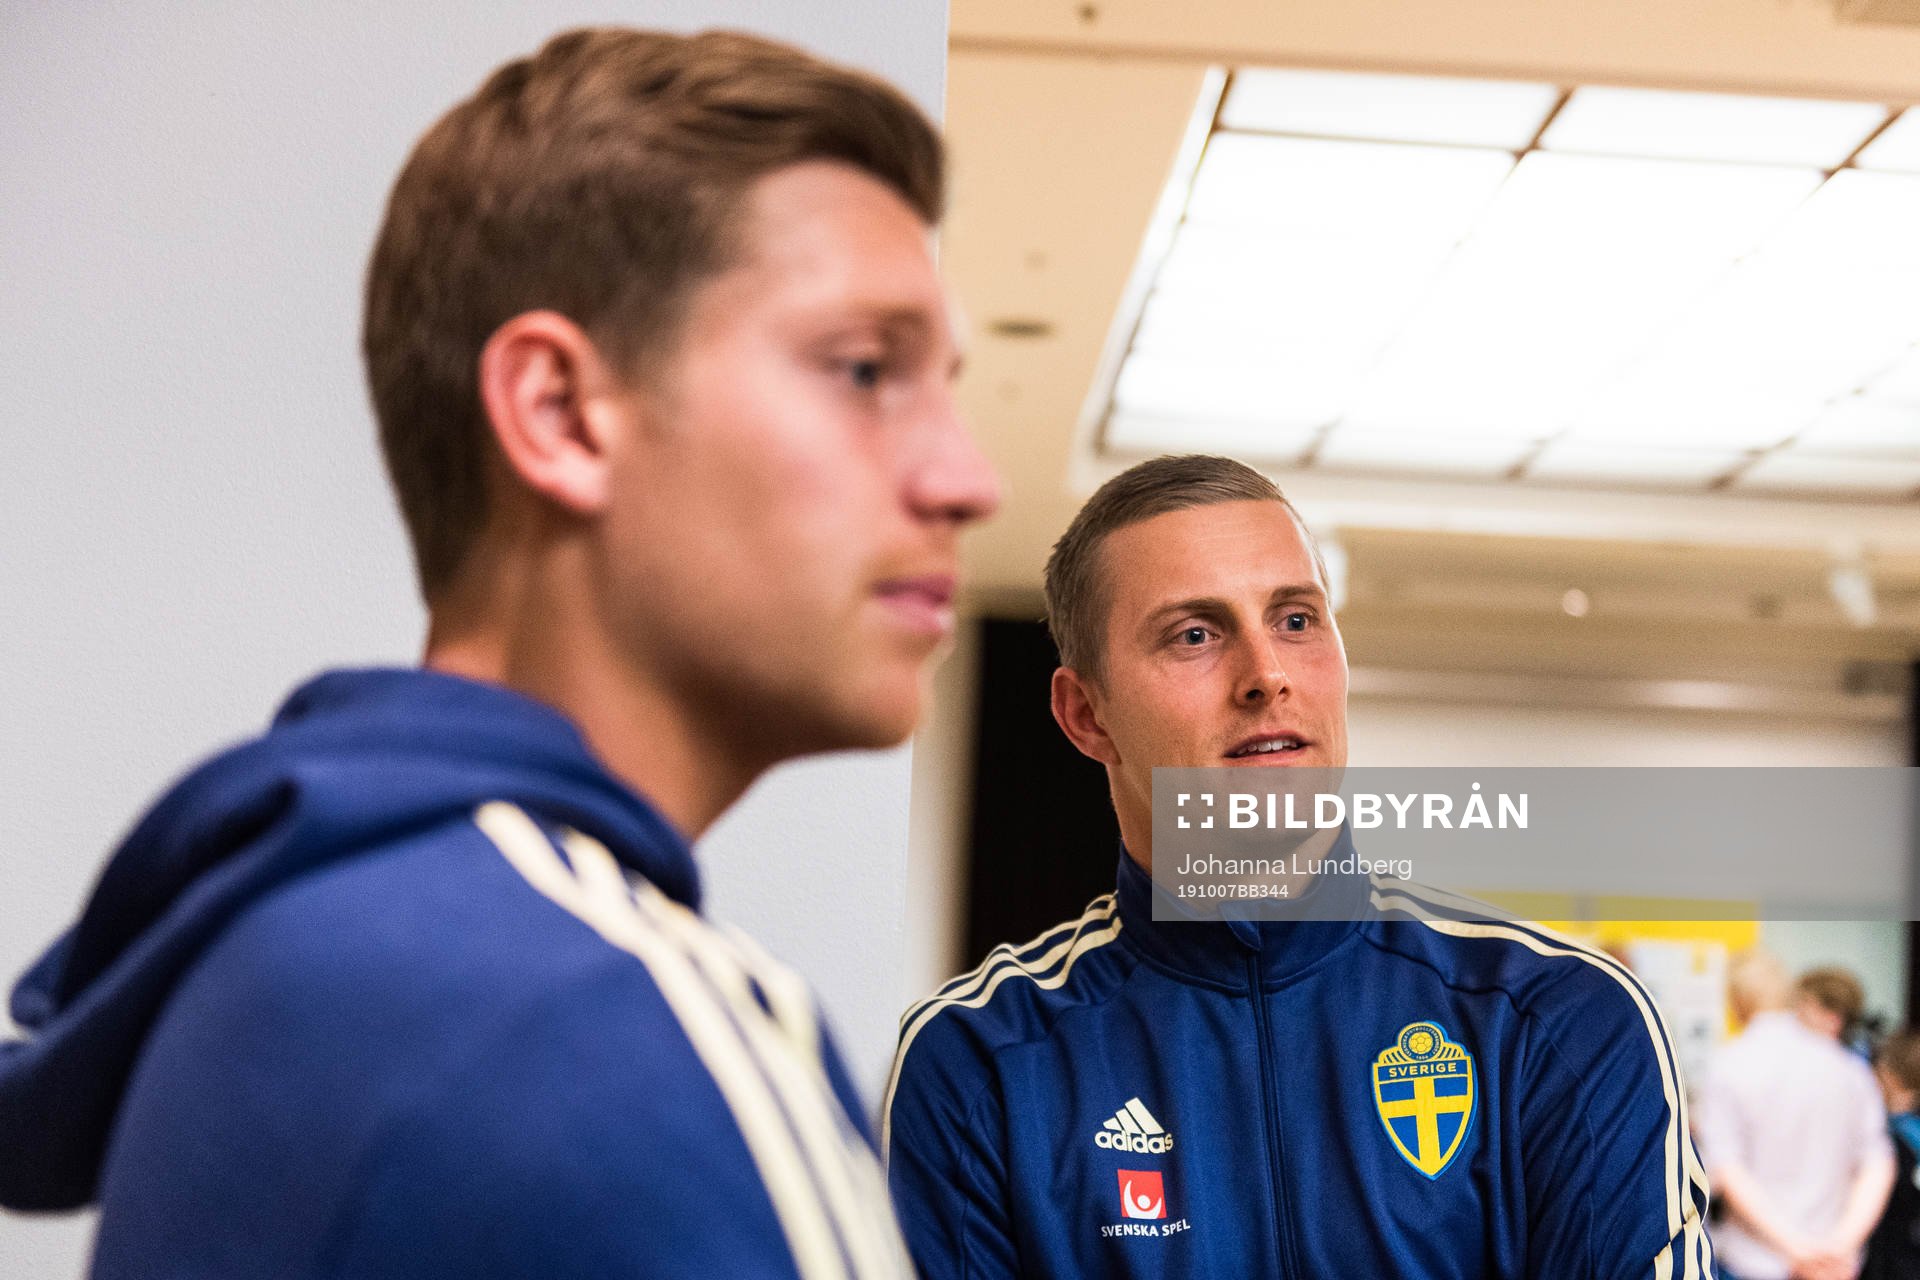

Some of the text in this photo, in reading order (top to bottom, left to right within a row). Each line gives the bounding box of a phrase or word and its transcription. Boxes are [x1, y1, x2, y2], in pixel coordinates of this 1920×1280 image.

[1388, 1062, 1457, 1077] SVERIGE
[1094, 1130, 1173, 1154] adidas
[1101, 1218, 1191, 1237] SVENSKA SPEL
